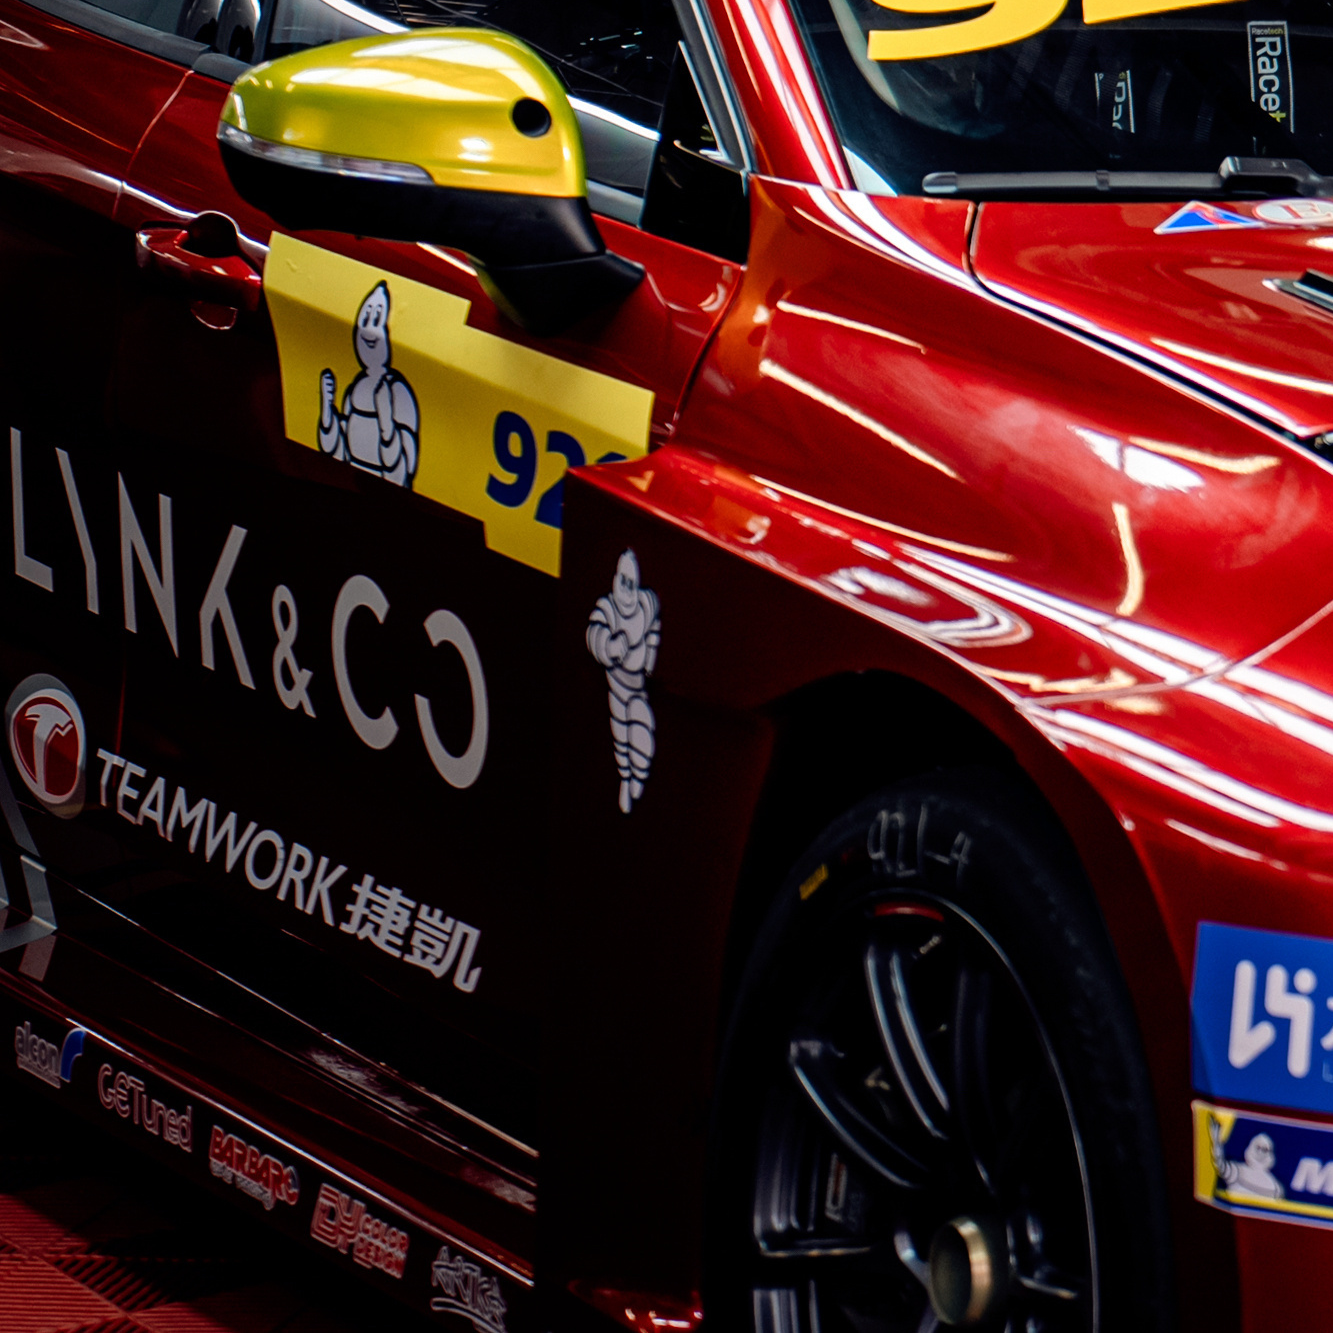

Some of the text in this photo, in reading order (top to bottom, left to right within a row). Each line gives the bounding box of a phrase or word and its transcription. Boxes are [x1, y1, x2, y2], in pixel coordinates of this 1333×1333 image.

[485, 410, 628, 531] 92
[97, 748, 348, 927] TEAMWORK
[15, 1021, 60, 1074] alcon
[97, 1063, 192, 1153] GETuned
